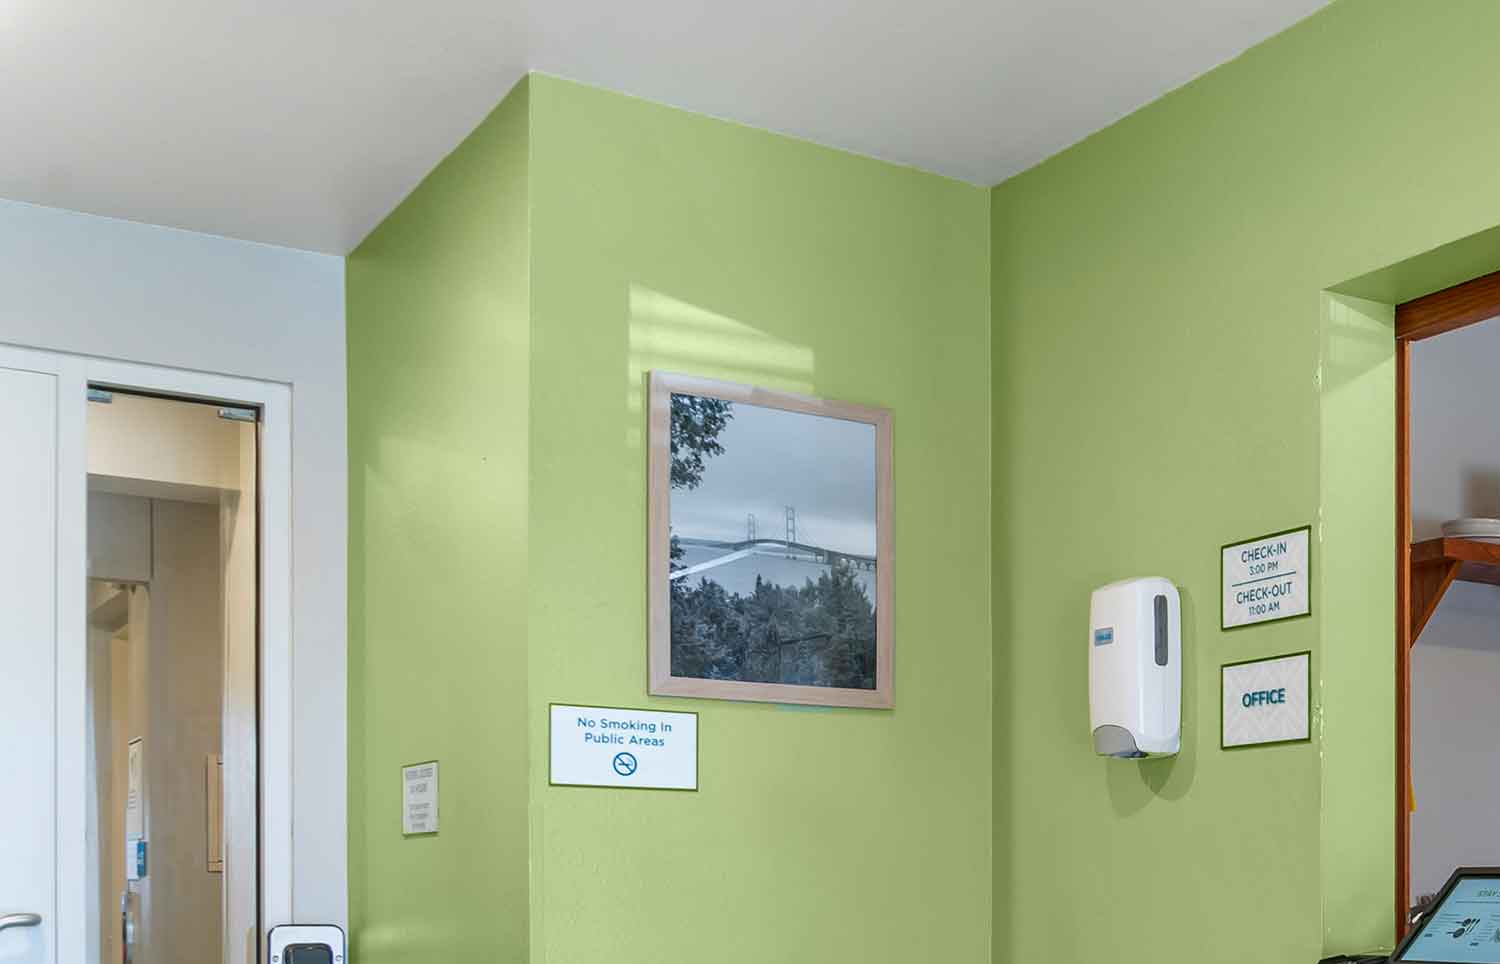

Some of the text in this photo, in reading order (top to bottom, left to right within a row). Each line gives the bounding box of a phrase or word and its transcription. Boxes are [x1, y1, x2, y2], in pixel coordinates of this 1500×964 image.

[1241, 542, 1287, 563] CHECK-IN
[1267, 561, 1279, 571] PM
[1236, 582, 1292, 604] CHECK-OUT
[1248, 601, 1280, 615] 11:00 AM
[1242, 688, 1286, 708] OFFICE
[577, 717, 672, 733] No Smoking In
[585, 732, 665, 746] Public Areas
